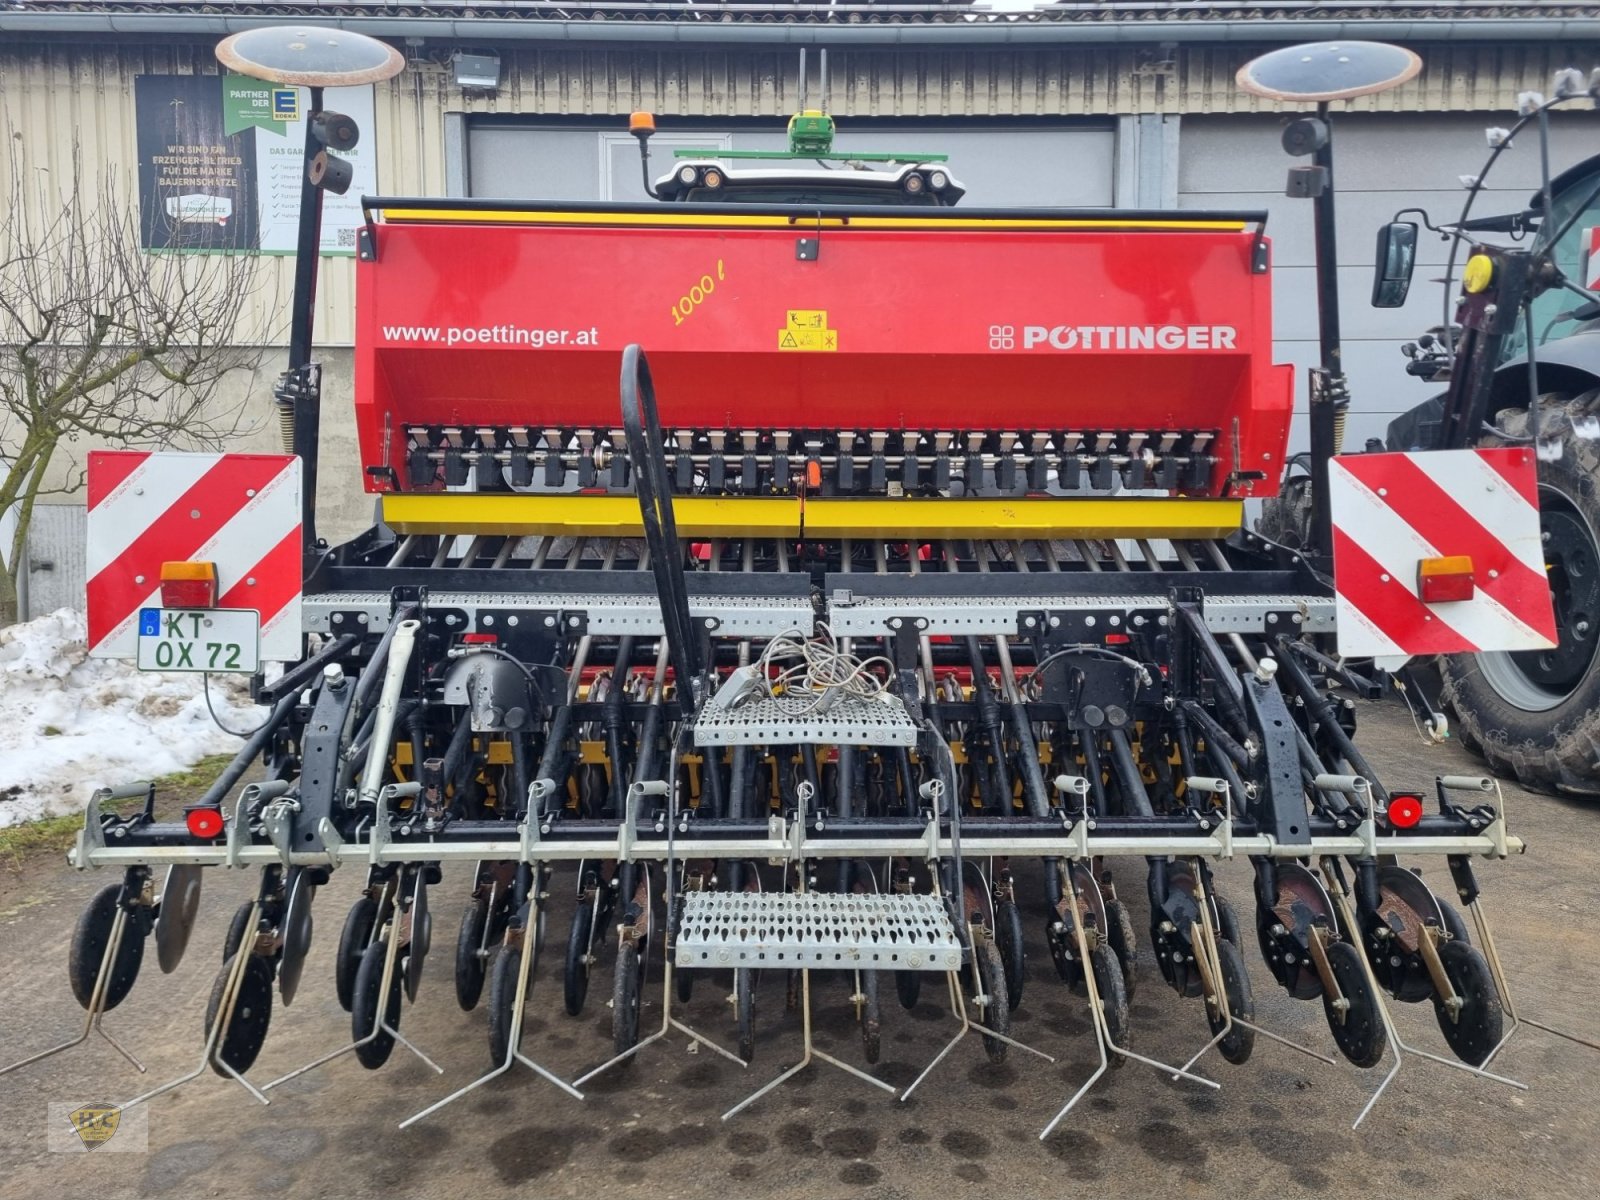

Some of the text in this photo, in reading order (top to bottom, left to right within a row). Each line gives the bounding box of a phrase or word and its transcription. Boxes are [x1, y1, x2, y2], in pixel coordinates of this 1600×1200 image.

[230, 90, 269, 98] PARTNER
[252, 99, 269, 107] DER
[168, 145, 226, 155] WIR SIND EIN
[182, 167, 198, 175] DIE
[200, 167, 232, 176] MARKE
[672, 275, 714, 326] 1000
[382, 325, 599, 348] www.poettinger.at
[1023, 326, 1237, 349] PÖTTINGER
[146, 625, 154, 634] D
[167, 612, 205, 639] KT
[155, 641, 241, 669] OX 72
